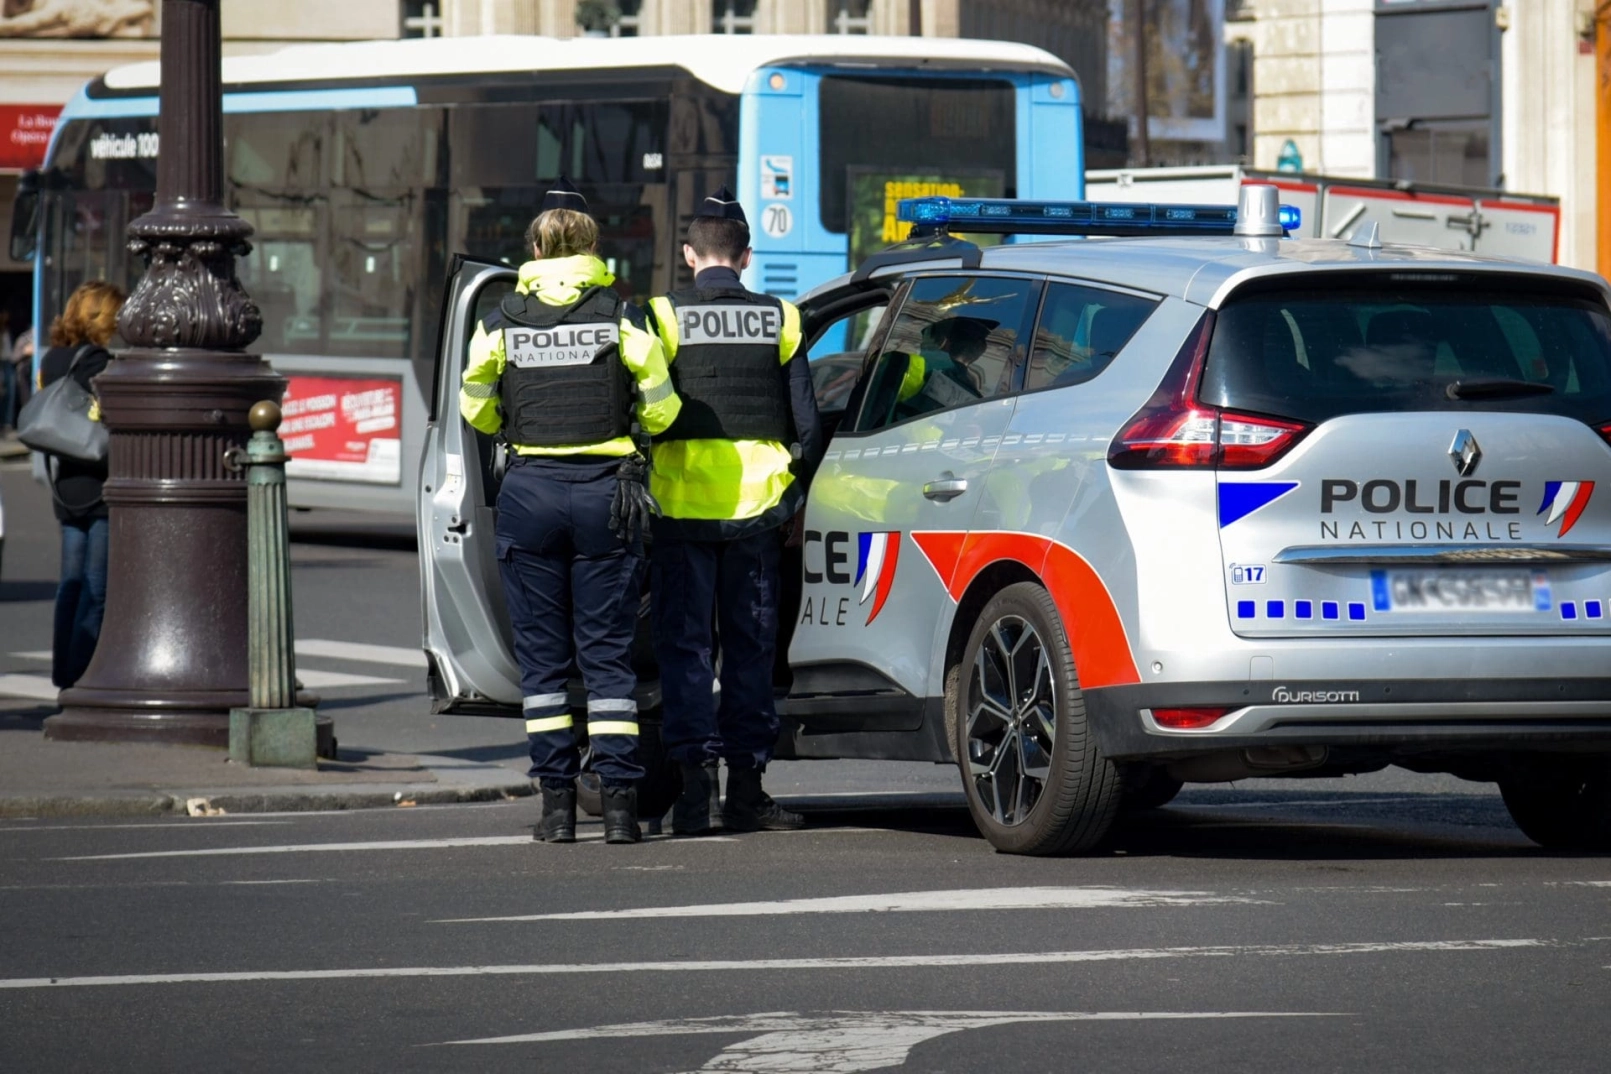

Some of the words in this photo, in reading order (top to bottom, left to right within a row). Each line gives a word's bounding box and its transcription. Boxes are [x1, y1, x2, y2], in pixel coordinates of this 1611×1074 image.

[91, 132, 137, 159] véhicule
[769, 208, 787, 233] 70
[683, 310, 776, 339] POLICE
[513, 329, 611, 350] POLICE
[514, 350, 597, 362] NATIONA
[1321, 479, 1521, 514] POLICE
[1321, 521, 1522, 540] NATIONALE
[1244, 567, 1264, 582] 17
[1272, 686, 1360, 702] DURISOTTI
